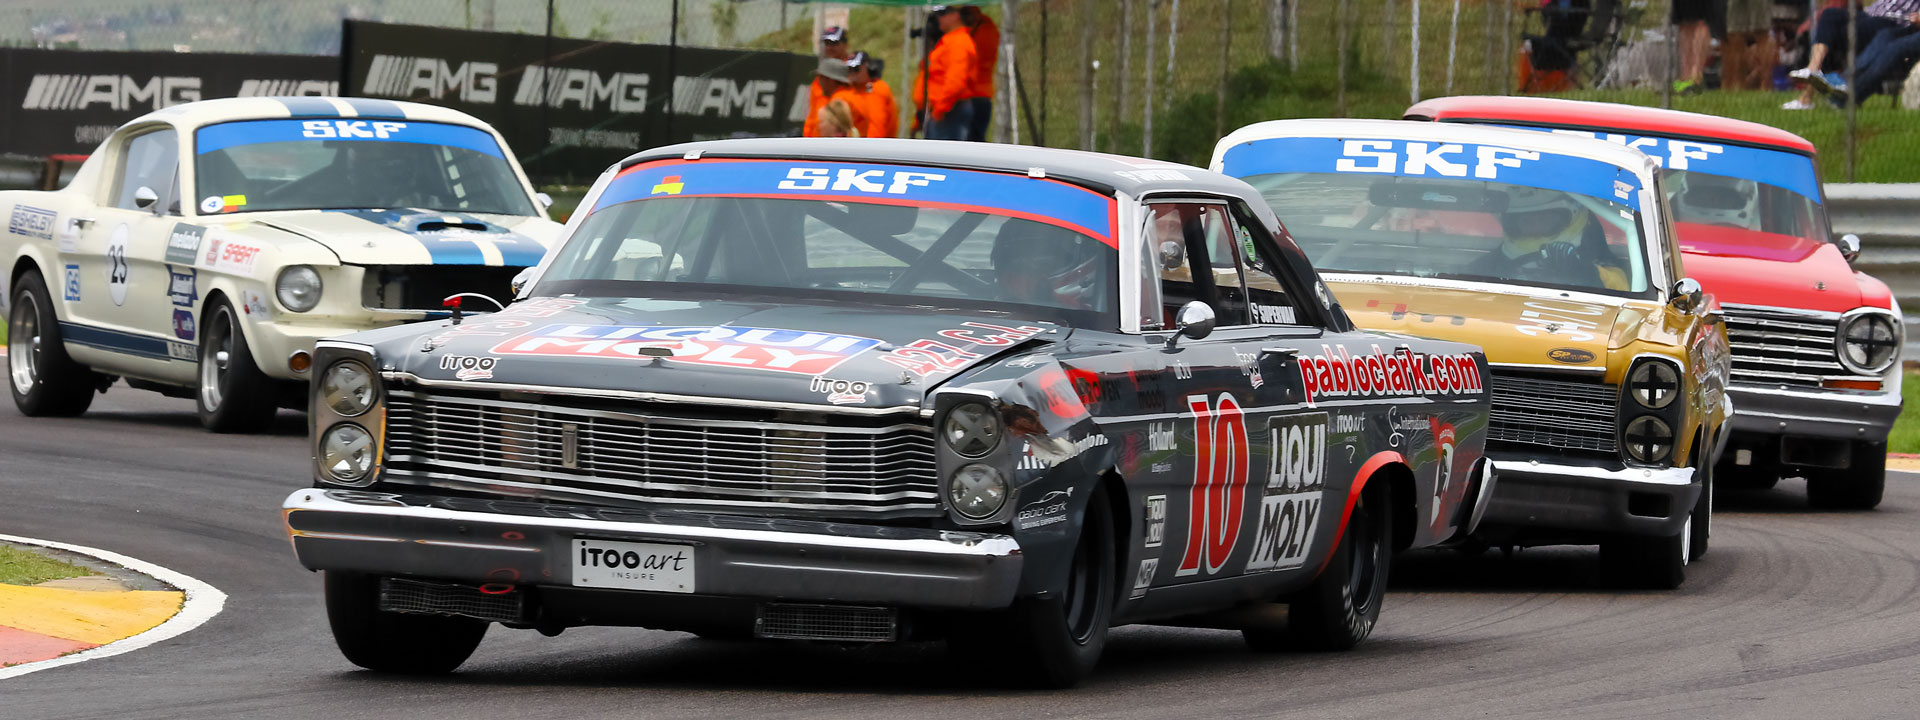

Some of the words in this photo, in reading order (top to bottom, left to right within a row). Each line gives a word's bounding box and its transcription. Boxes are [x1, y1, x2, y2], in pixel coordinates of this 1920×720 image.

[78, 74, 202, 110] AMG
[406, 58, 498, 103] AMG
[557, 69, 649, 112] AMG
[699, 78, 777, 119] AMG
[302, 121, 406, 138] SKF
[1336, 140, 1540, 179] SKF
[778, 167, 946, 194] SKF
[108, 244, 128, 284] 23
[513, 337, 843, 368] MOLY
[546, 325, 863, 353] LIQUI
[1297, 344, 1484, 409] pabloclark.com
[1267, 423, 1326, 491] LIQUI
[1174, 391, 1250, 578] 10
[1252, 498, 1320, 563] MOLY
[611, 571, 656, 581] INSURE
[644, 551, 688, 572] art
